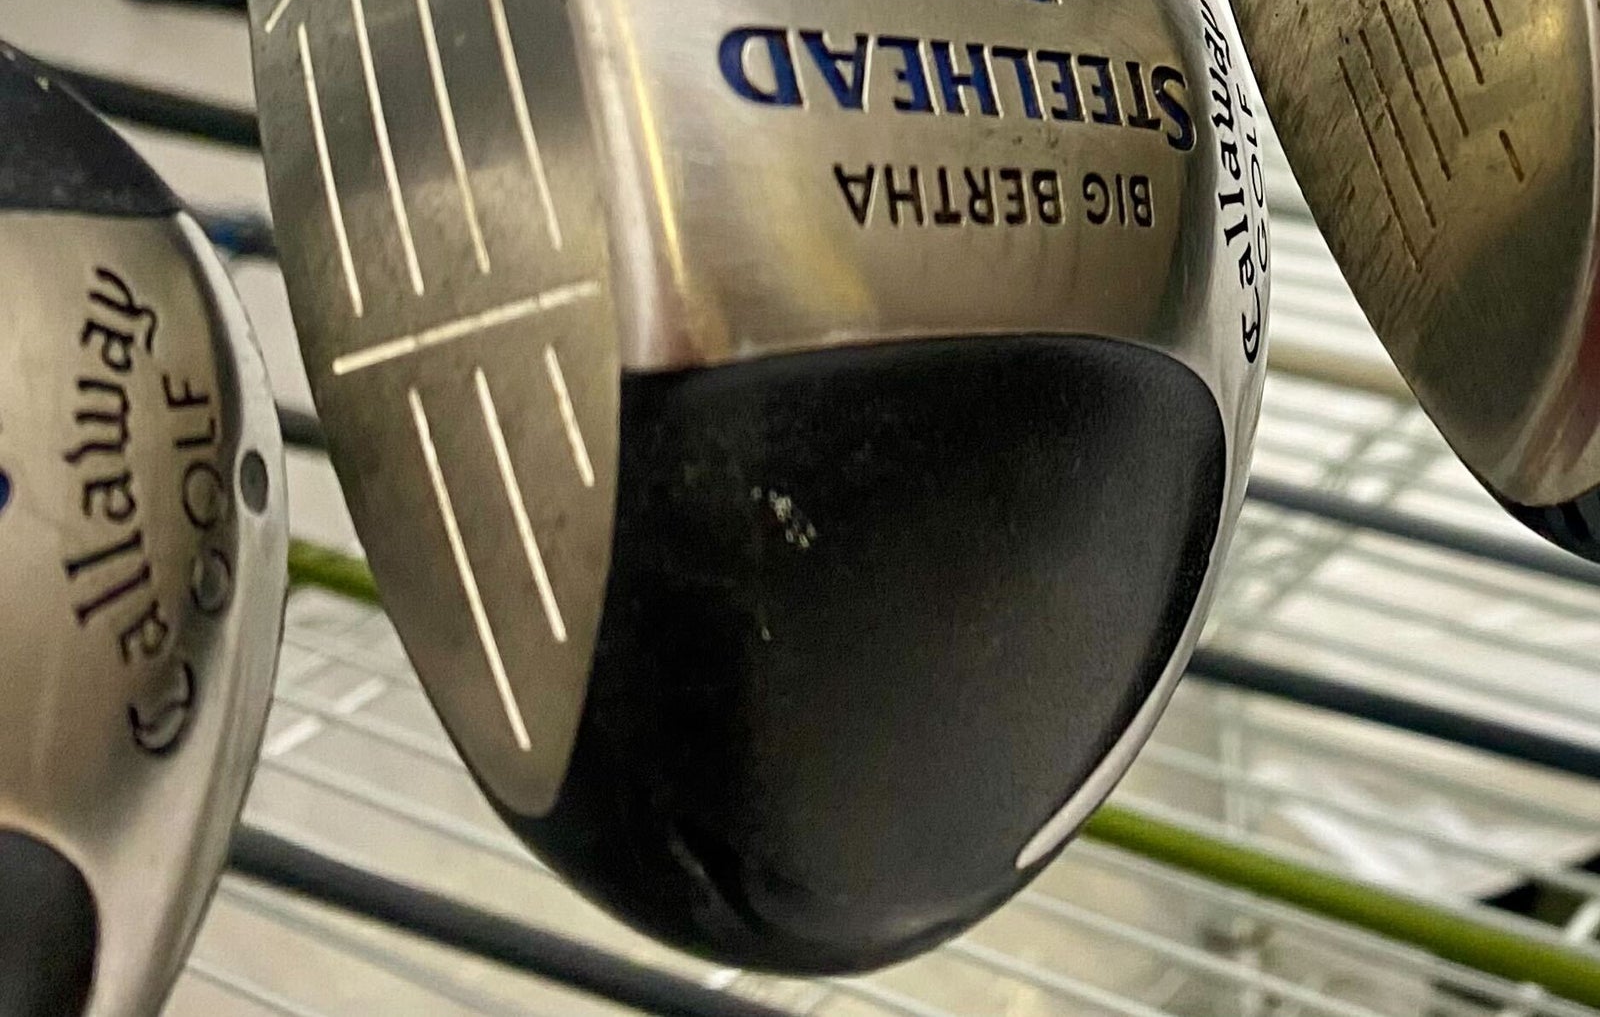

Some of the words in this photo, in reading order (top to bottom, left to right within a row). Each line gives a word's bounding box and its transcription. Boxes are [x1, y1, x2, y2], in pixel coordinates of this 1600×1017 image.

[717, 26, 1197, 151] STEELHEAD
[833, 163, 1067, 228] BERTHA
[1082, 170, 1155, 228] BIG
[1237, 83, 1269, 274] GOLF
[63, 267, 196, 755] Callaway
[163, 372, 233, 618] GOLF
